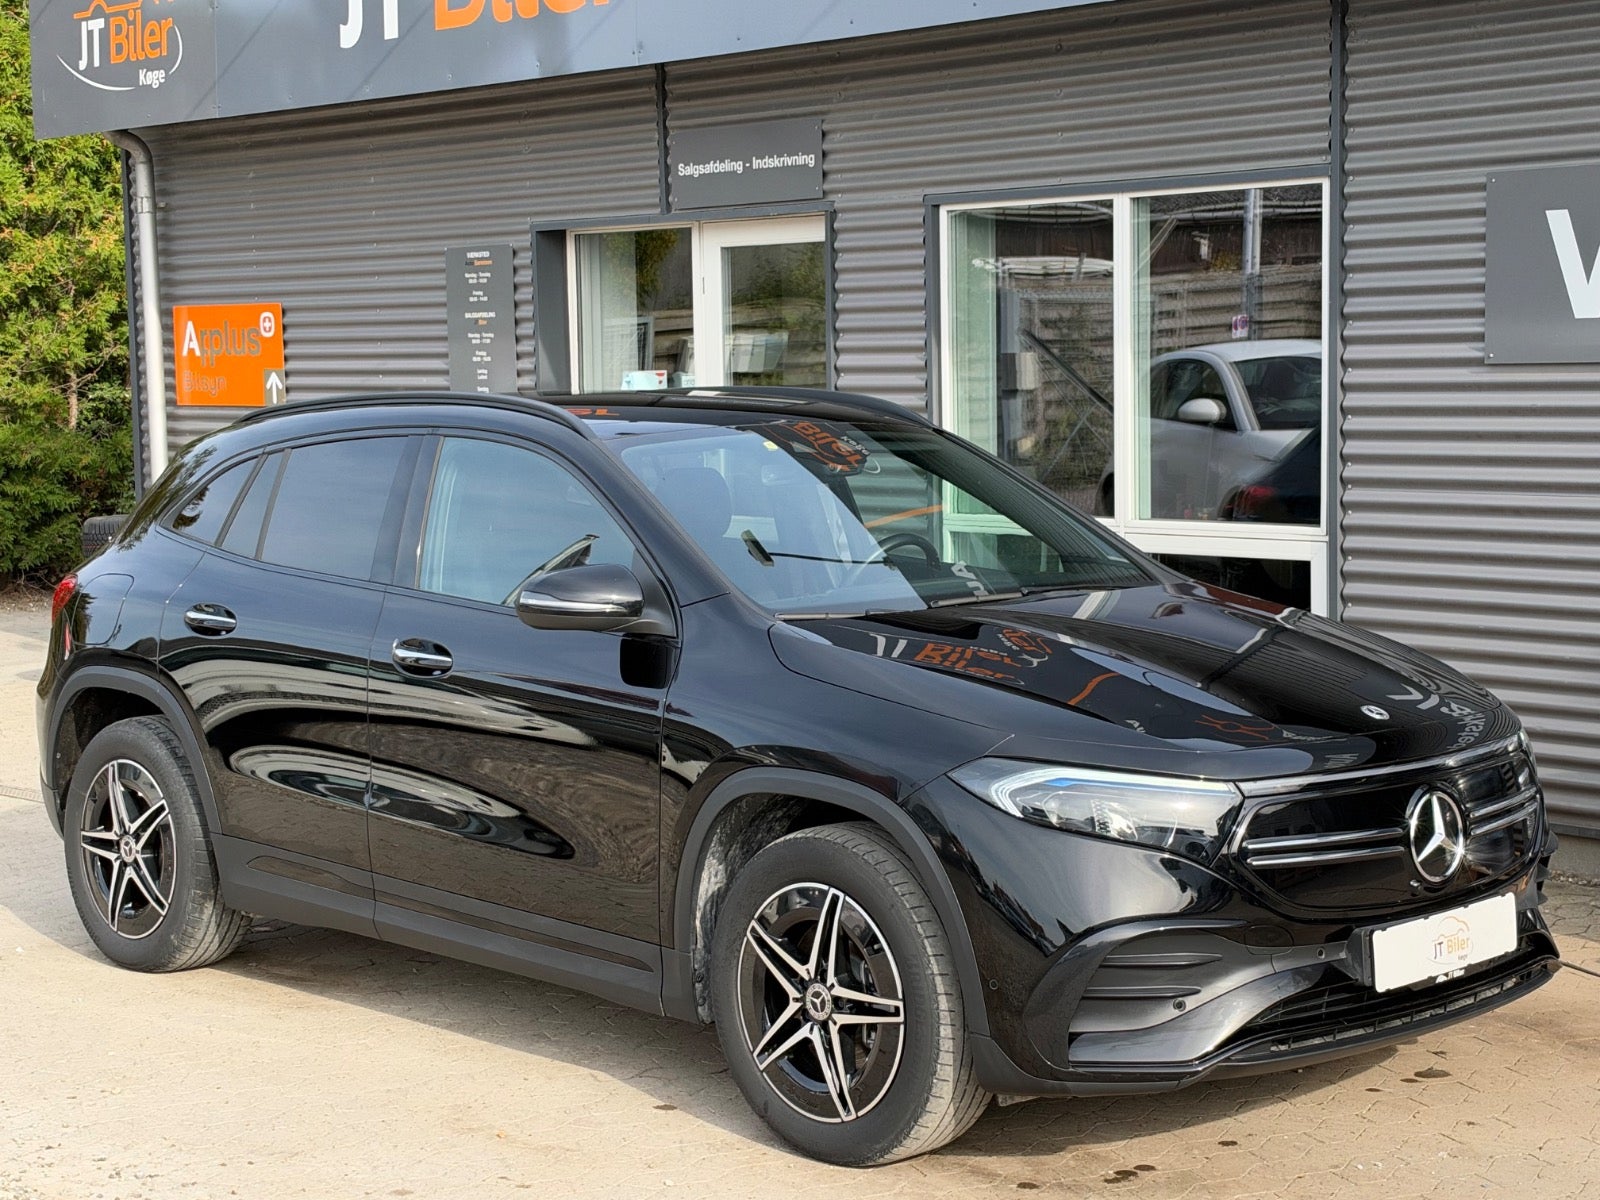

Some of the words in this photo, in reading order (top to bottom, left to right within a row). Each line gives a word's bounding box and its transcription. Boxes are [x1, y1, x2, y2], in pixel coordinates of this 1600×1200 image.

[79, 18, 105, 71] JT
[110, 9, 173, 64] Biler
[139, 69, 165, 88] Køge
[678, 159, 743, 178] Salgsafdeling
[752, 152, 815, 170] Indskrivning
[1434, 941, 1444, 960] JT
[1447, 935, 1470, 954] Biler
